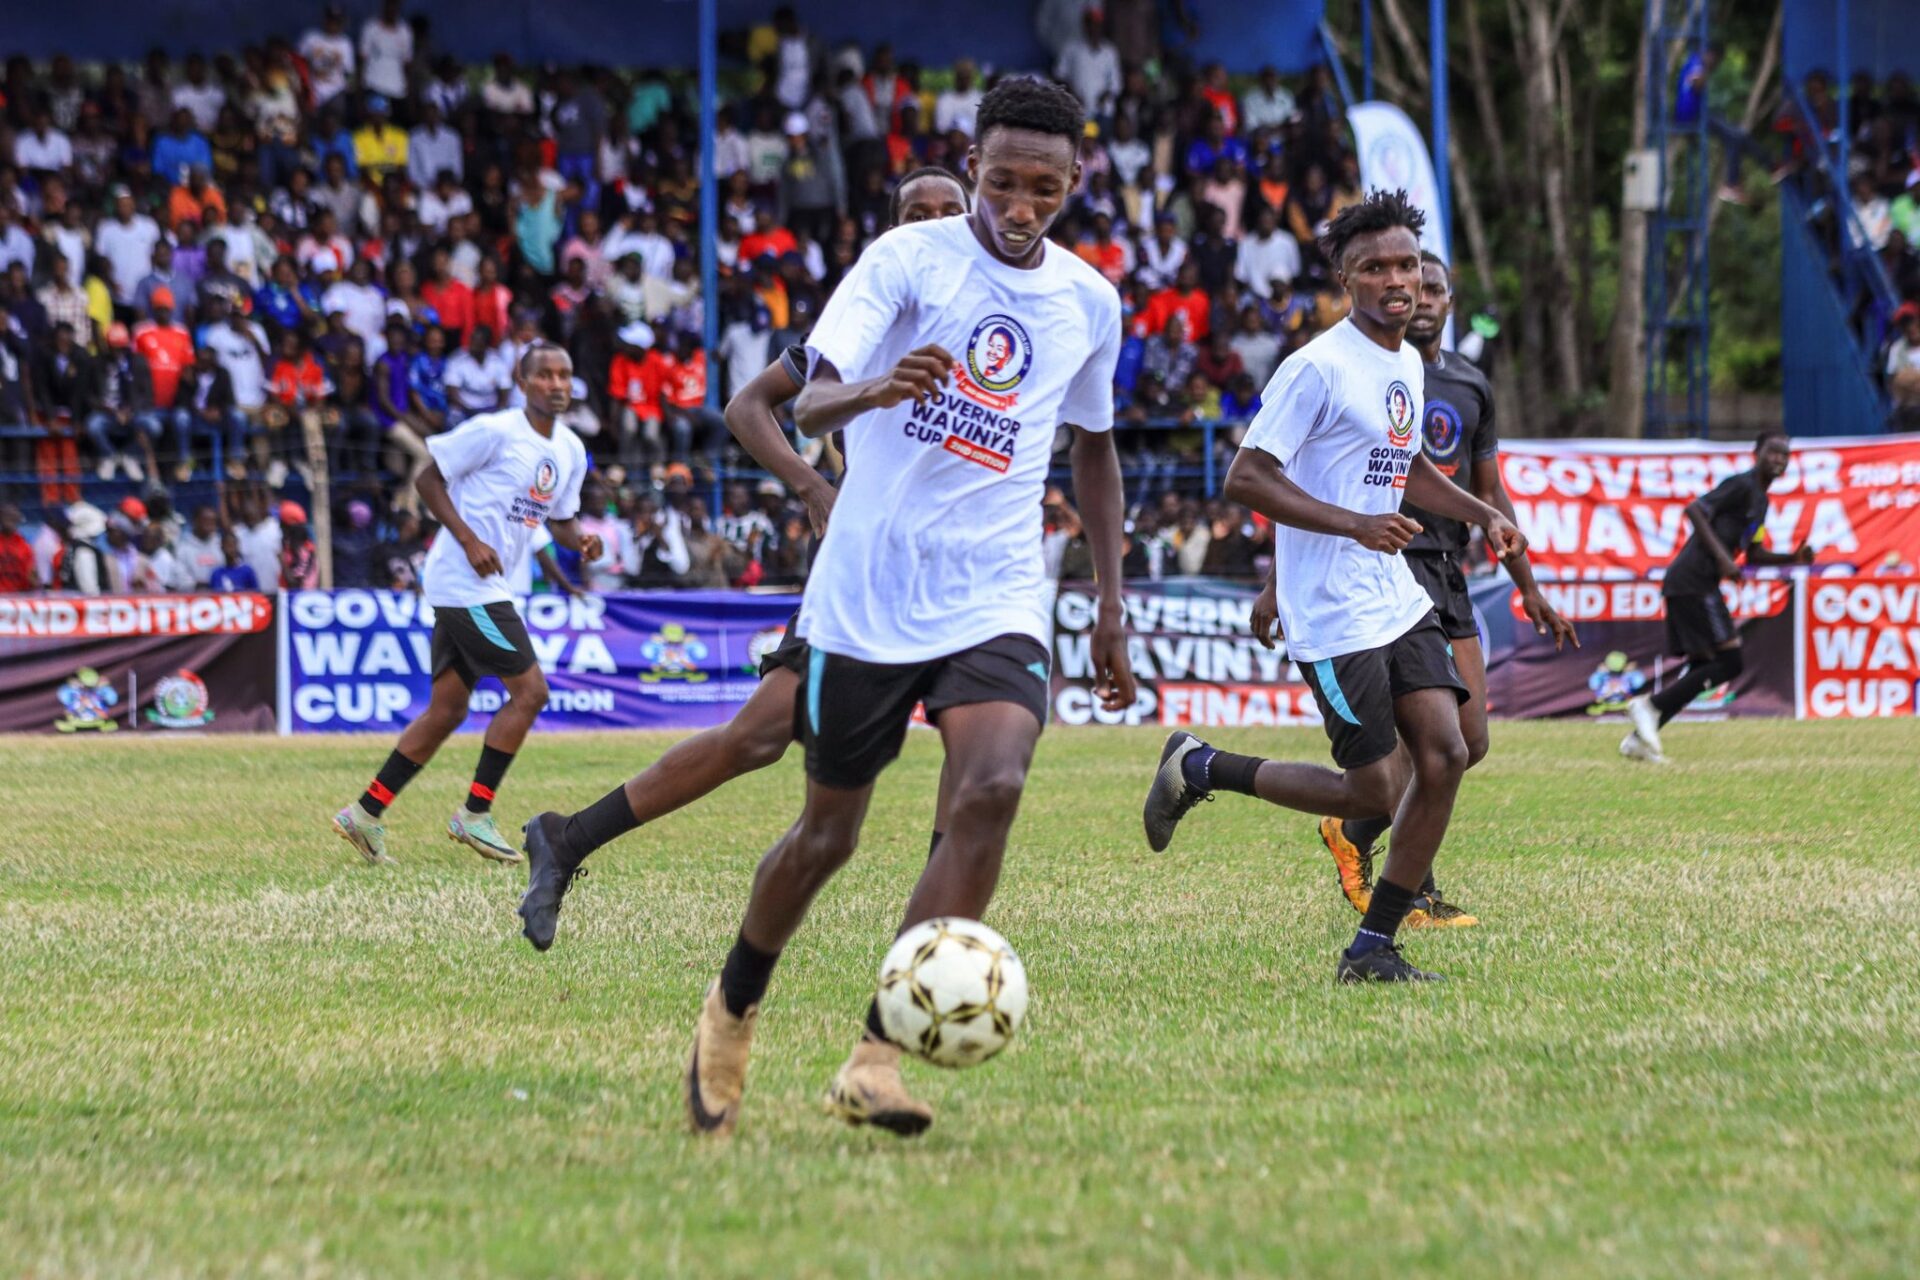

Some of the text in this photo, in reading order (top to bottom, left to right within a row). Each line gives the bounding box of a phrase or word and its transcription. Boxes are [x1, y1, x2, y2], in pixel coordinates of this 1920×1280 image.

[904, 421, 943, 445] CUP
[912, 400, 1015, 457] WAVINYA
[1364, 474, 1392, 487] CUP
[1514, 497, 1858, 558] WAVYA
[85, 596, 254, 633] EDITION
[293, 682, 412, 724] CUP
[1162, 688, 1325, 727] FINALS
[1810, 677, 1911, 719] CUP
